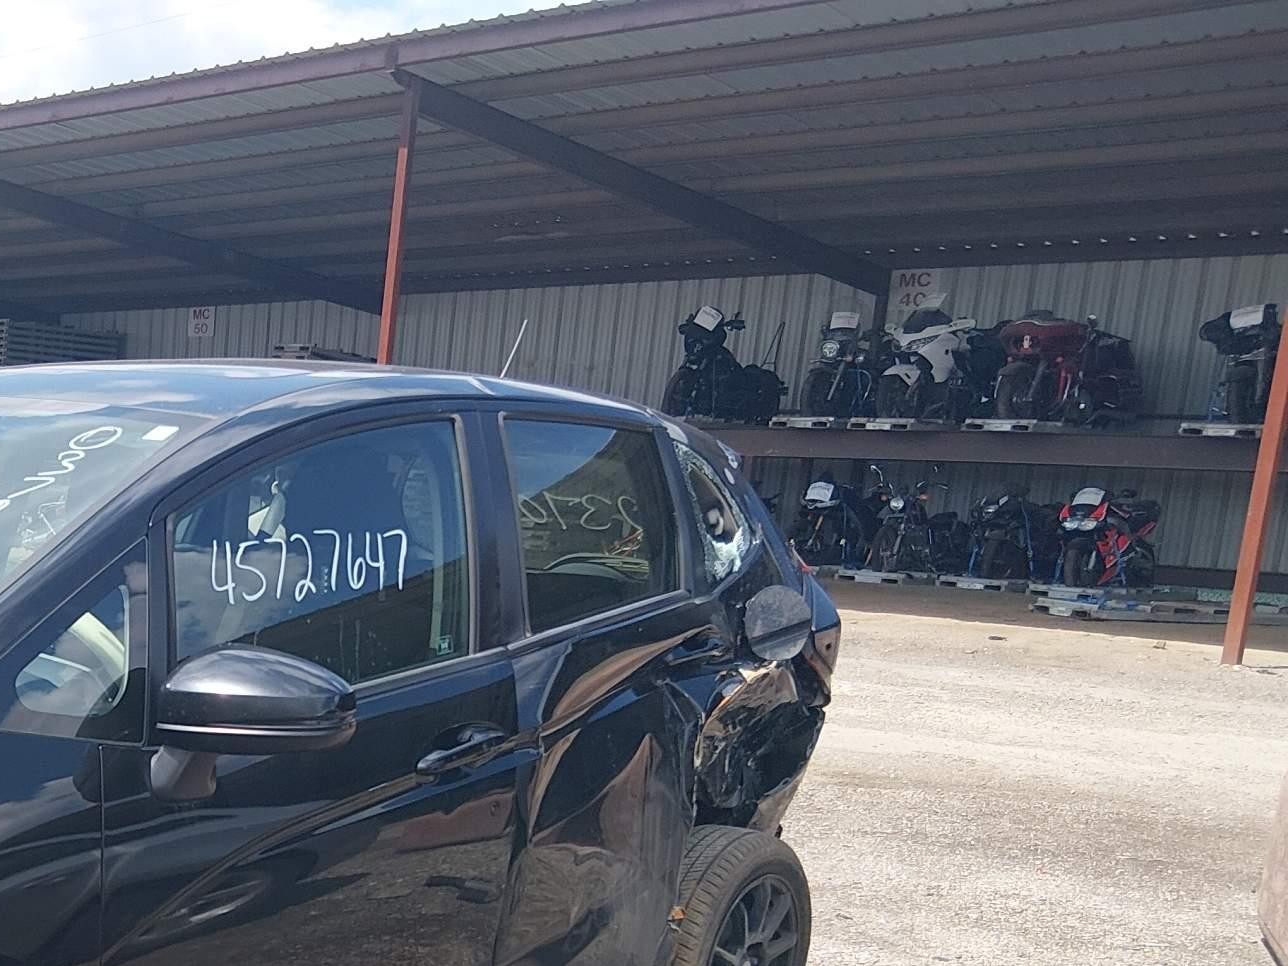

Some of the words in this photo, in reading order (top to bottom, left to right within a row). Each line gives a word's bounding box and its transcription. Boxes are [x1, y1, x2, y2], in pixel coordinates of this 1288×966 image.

[899, 272, 931, 288] MC
[193, 308, 210, 321] MC
[193, 322, 209, 334] 50
[211, 529, 409, 605] 45727647
